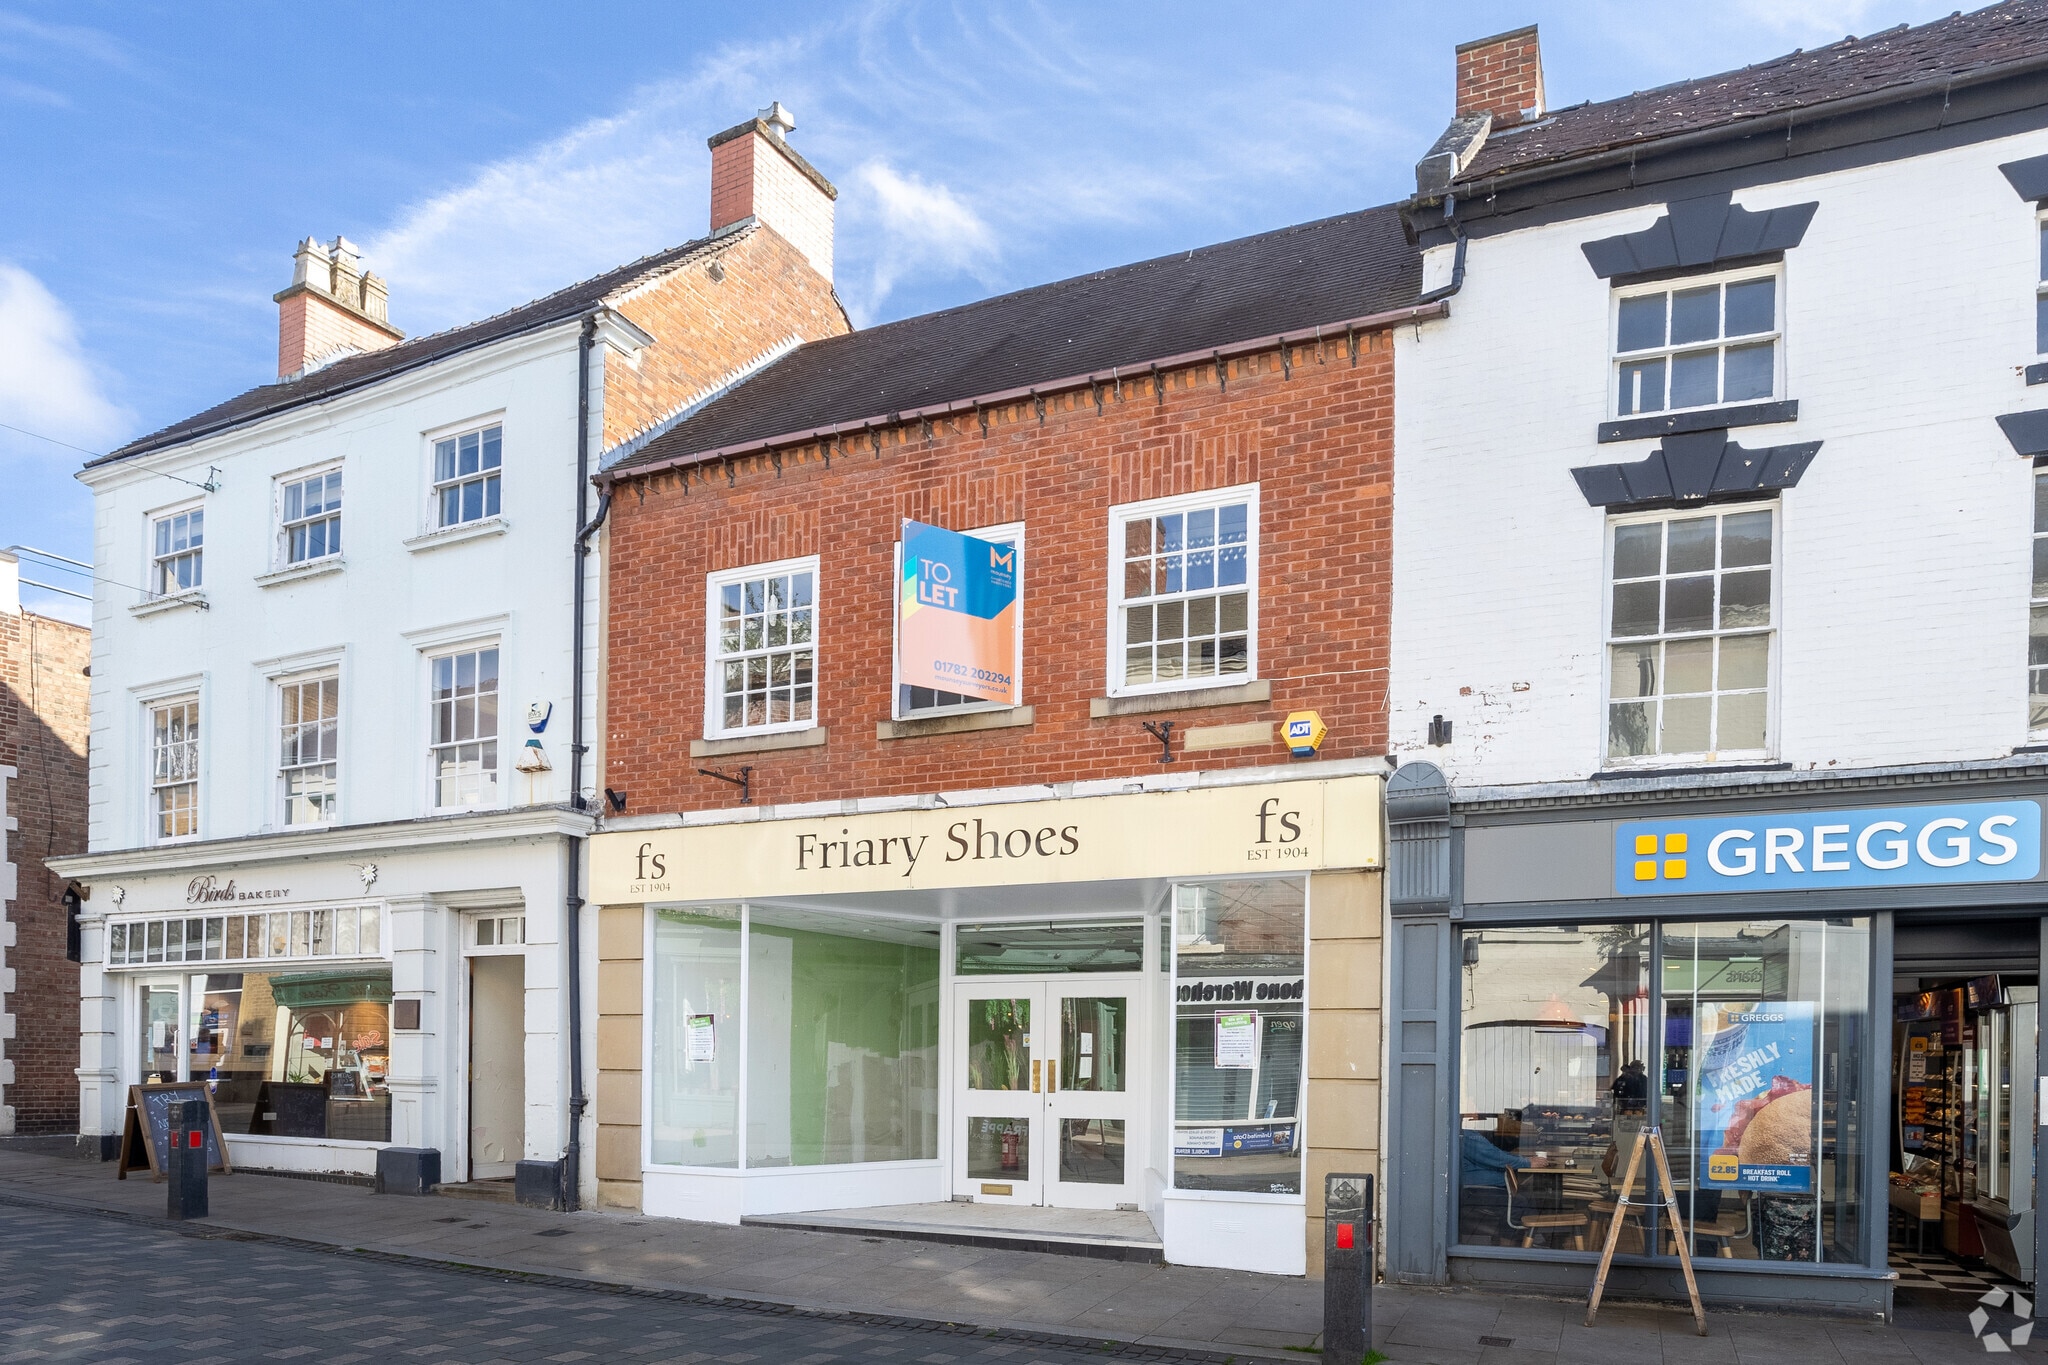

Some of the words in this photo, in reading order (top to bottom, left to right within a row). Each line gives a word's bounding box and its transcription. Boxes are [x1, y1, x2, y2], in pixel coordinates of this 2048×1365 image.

[920, 558, 951, 583] TO
[990, 546, 1012, 573] M
[920, 580, 959, 608] LET
[934, 660, 968, 676] 01782
[970, 667, 1011, 686] 202294
[1290, 722, 1311, 736] ADT
[1255, 797, 1301, 844] fs
[795, 828, 929, 877] Friary
[945, 818, 1080, 862] Shoes
[1247, 848, 1271, 860] EST
[1276, 846, 1308, 859] 1904
[1706, 814, 2019, 877] GREGGS
[635, 842, 666, 880] fs
[187, 874, 236, 904] Birds
[238, 888, 290, 901] BAKERY
[630, 884, 646, 893] EST
[649, 882, 671, 892] 1904
[1741, 1013, 1784, 1022] GREGGS
[1706, 1041, 1781, 1088] FRESHLY
[153, 1091, 179, 1107] TRY
[1715, 1070, 1766, 1104] MADE
[1711, 1165, 1737, 1174] £2.85
